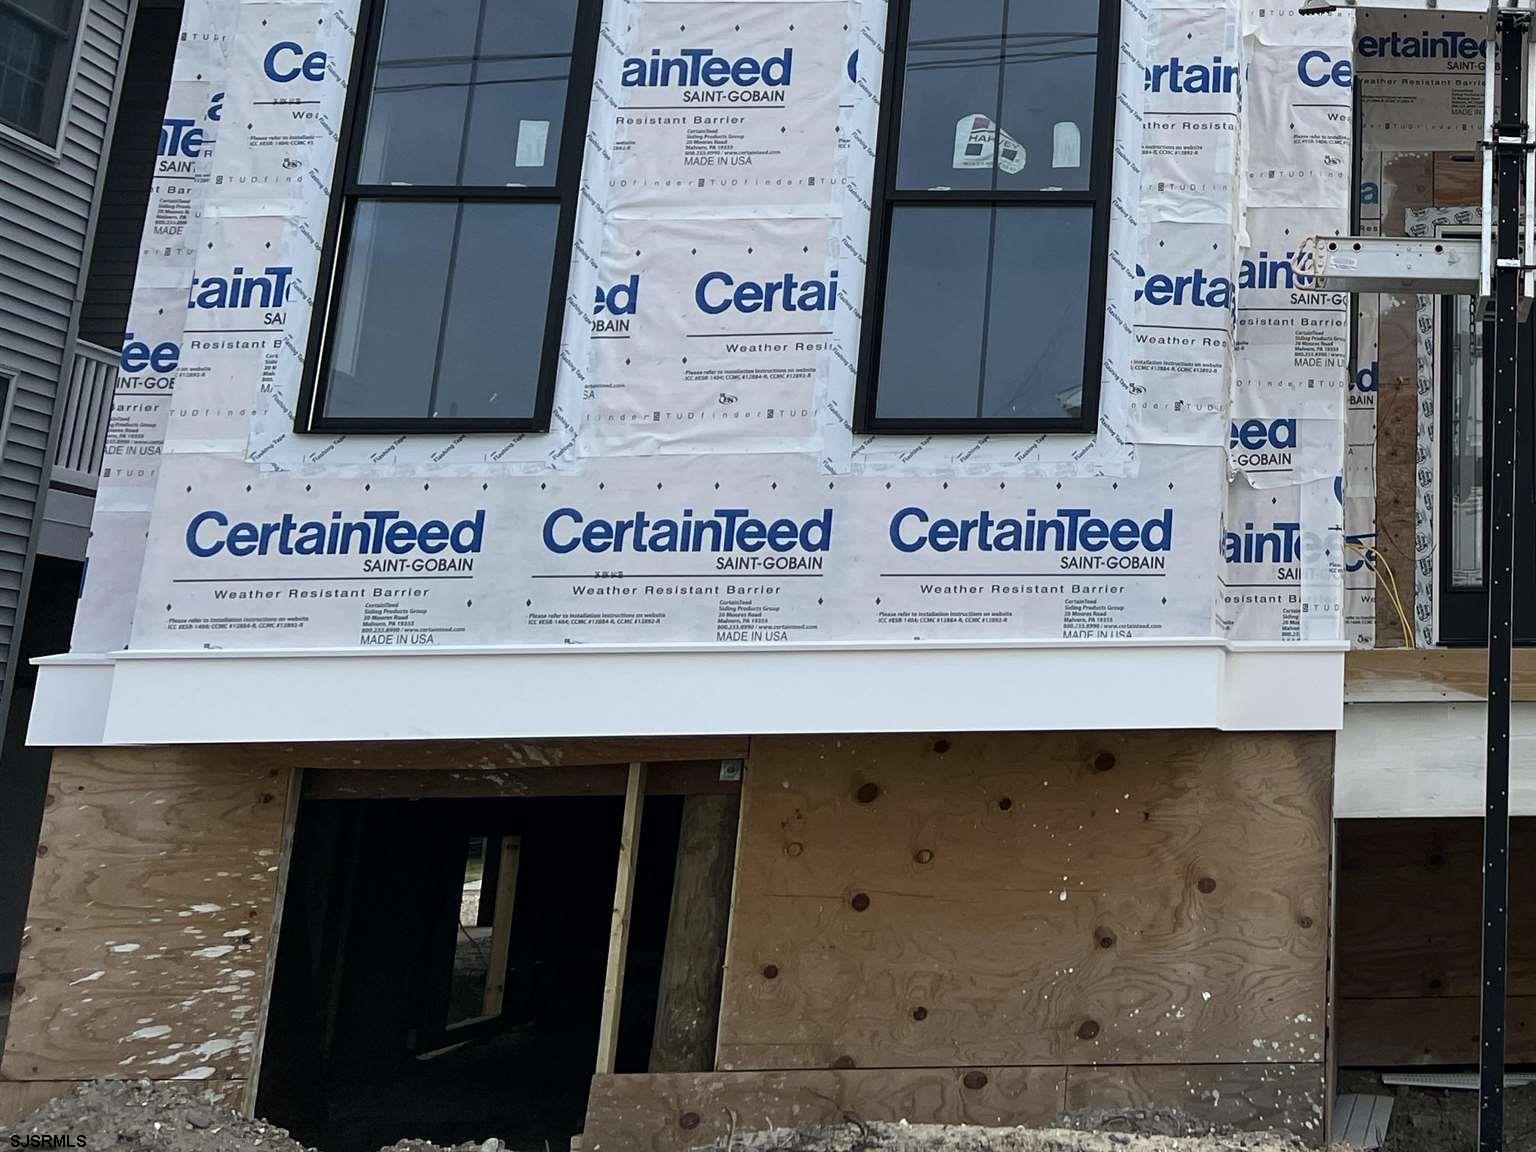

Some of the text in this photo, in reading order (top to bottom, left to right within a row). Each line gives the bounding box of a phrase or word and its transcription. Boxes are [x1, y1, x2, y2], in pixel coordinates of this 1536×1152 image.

[683, 90, 785, 103] SAINT-GOBAIN
[616, 116, 745, 125] Resistant Barrier
[684, 156, 752, 166] MADE IN USA
[192, 341, 265, 349] Resistant
[1136, 335, 1196, 345] Weather
[726, 344, 788, 353] Weather
[1294, 359, 1322, 367] MADE
[140, 447, 161, 455] USA
[186, 510, 486, 557] CertainTeed
[543, 508, 832, 554] CertainTeed
[890, 507, 1172, 553] CertainTeed
[363, 558, 473, 573] SAINT-GOBAIN
[716, 557, 823, 571] SAINT-GOBAIN
[1060, 556, 1165, 570] SAINT-GOBAIN
[214, 588, 429, 600] Weather Resistant Barrier
[573, 584, 780, 595] Weather Resistant Barrier
[921, 584, 1124, 594] Weather Resistant Barrier
[360, 634, 433, 645] MADE IN USA
[716, 631, 788, 642] MADE IN USA
